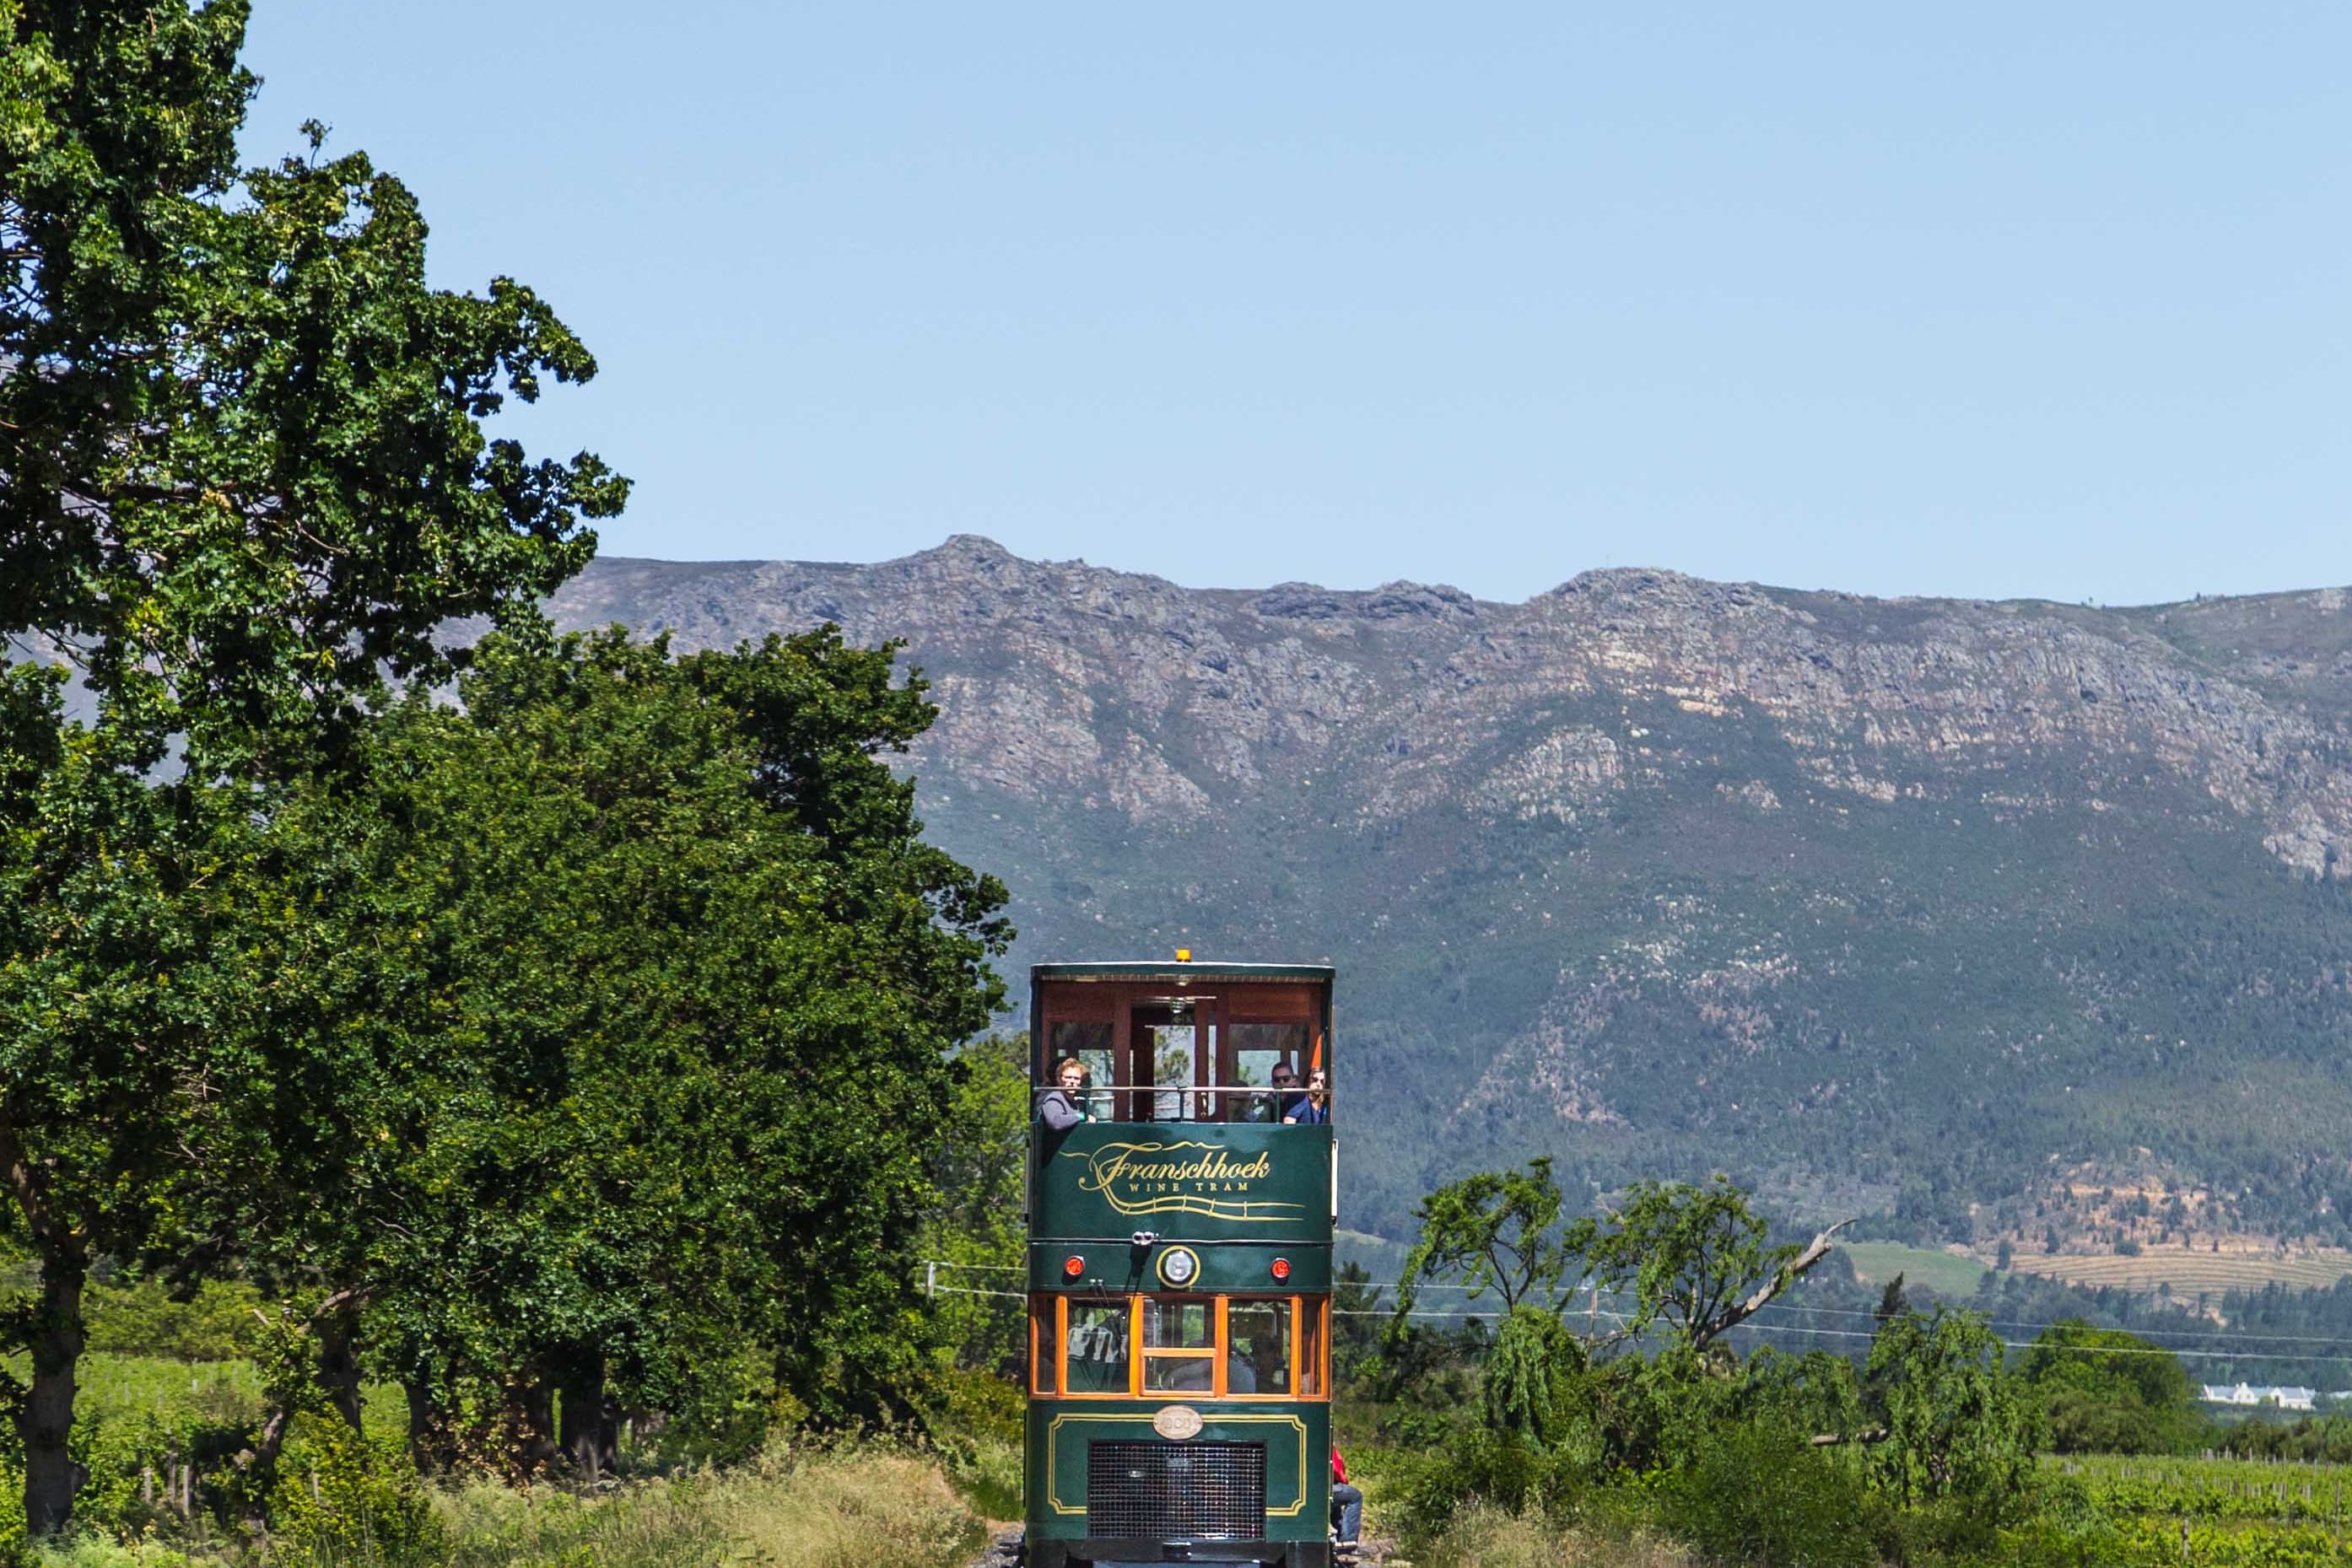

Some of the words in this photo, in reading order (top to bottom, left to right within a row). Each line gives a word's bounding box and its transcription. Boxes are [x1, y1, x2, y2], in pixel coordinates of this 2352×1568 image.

[1079, 1142, 1270, 1191] Franschhoek
[1129, 1183, 1180, 1192] WINE
[1195, 1182, 1248, 1192] TRAM
